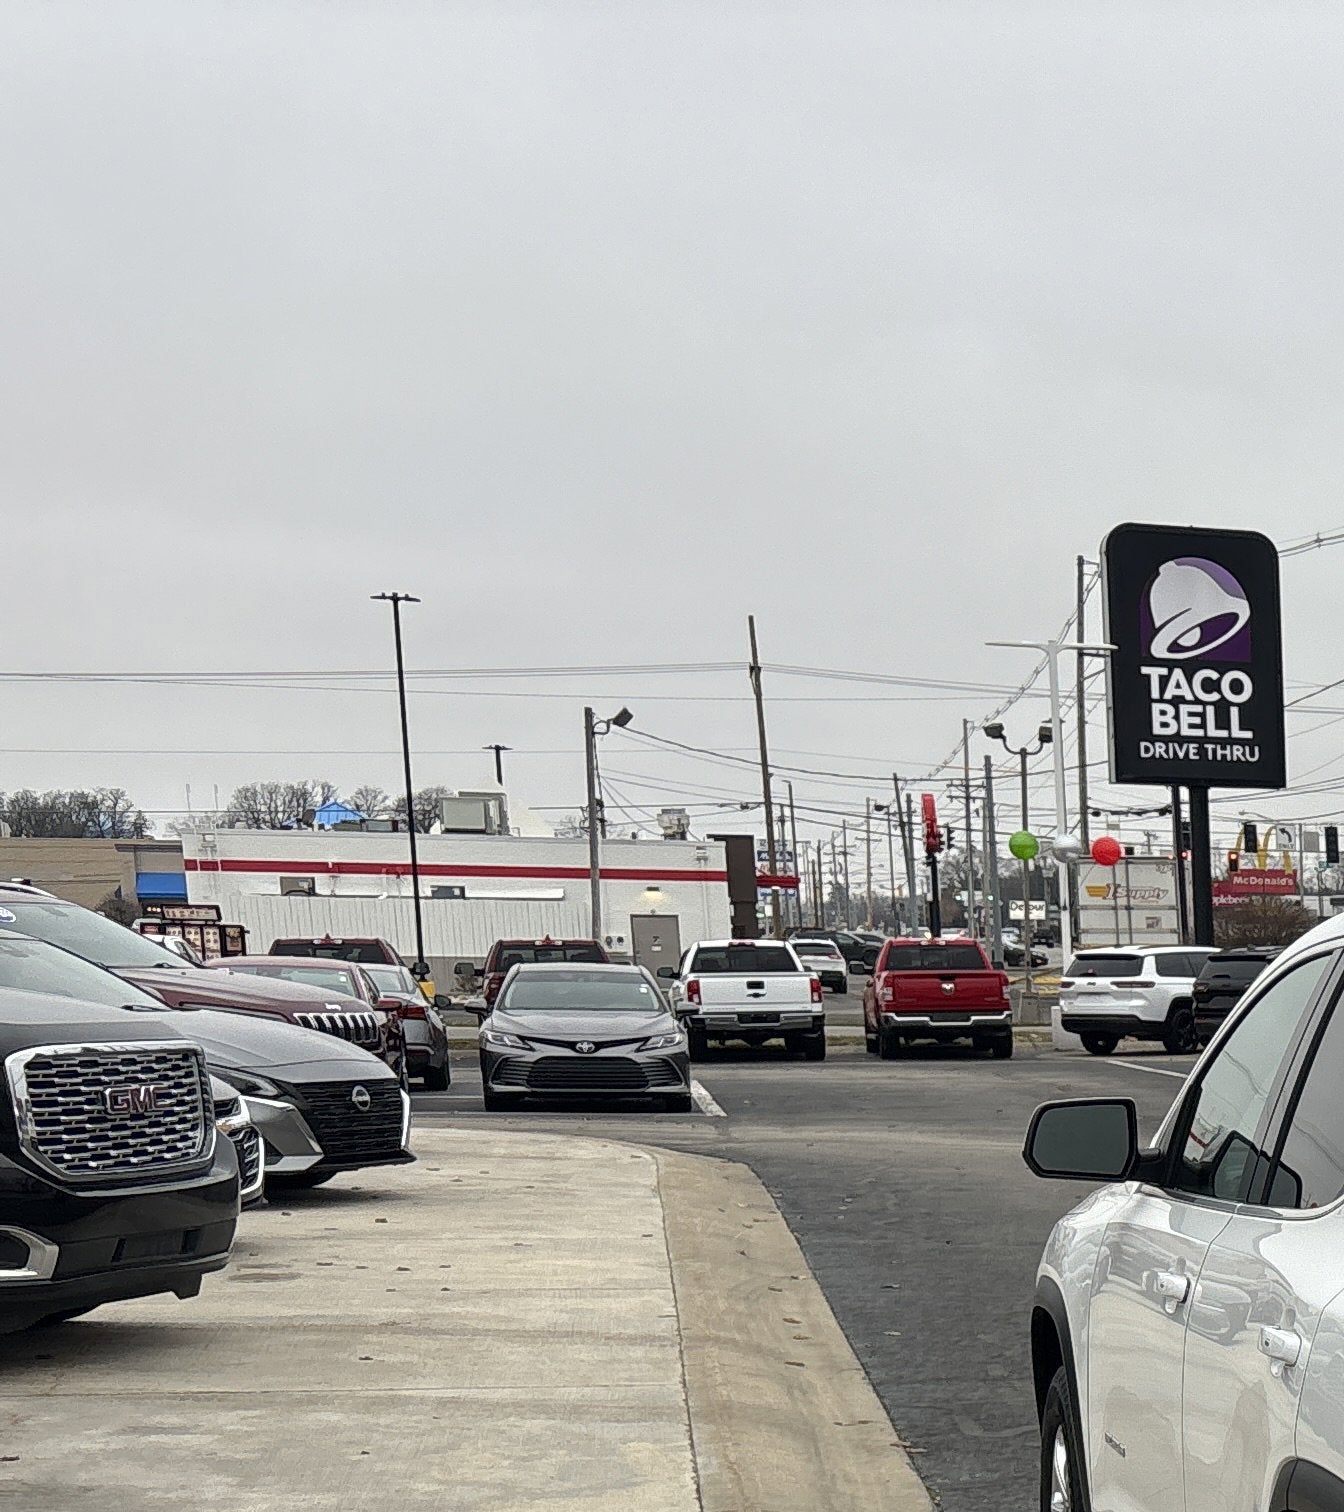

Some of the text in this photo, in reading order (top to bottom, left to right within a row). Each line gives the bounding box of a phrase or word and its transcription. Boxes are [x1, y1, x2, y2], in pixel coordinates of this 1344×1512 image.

[1140, 666, 1253, 704] TACO
[1151, 702, 1254, 739] BELL
[1139, 741, 1260, 762] DRIVE THRU
[1232, 876, 1294, 886] McDonald's
[1010, 900, 1045, 912] Deour
[104, 1084, 174, 1115] GMC
